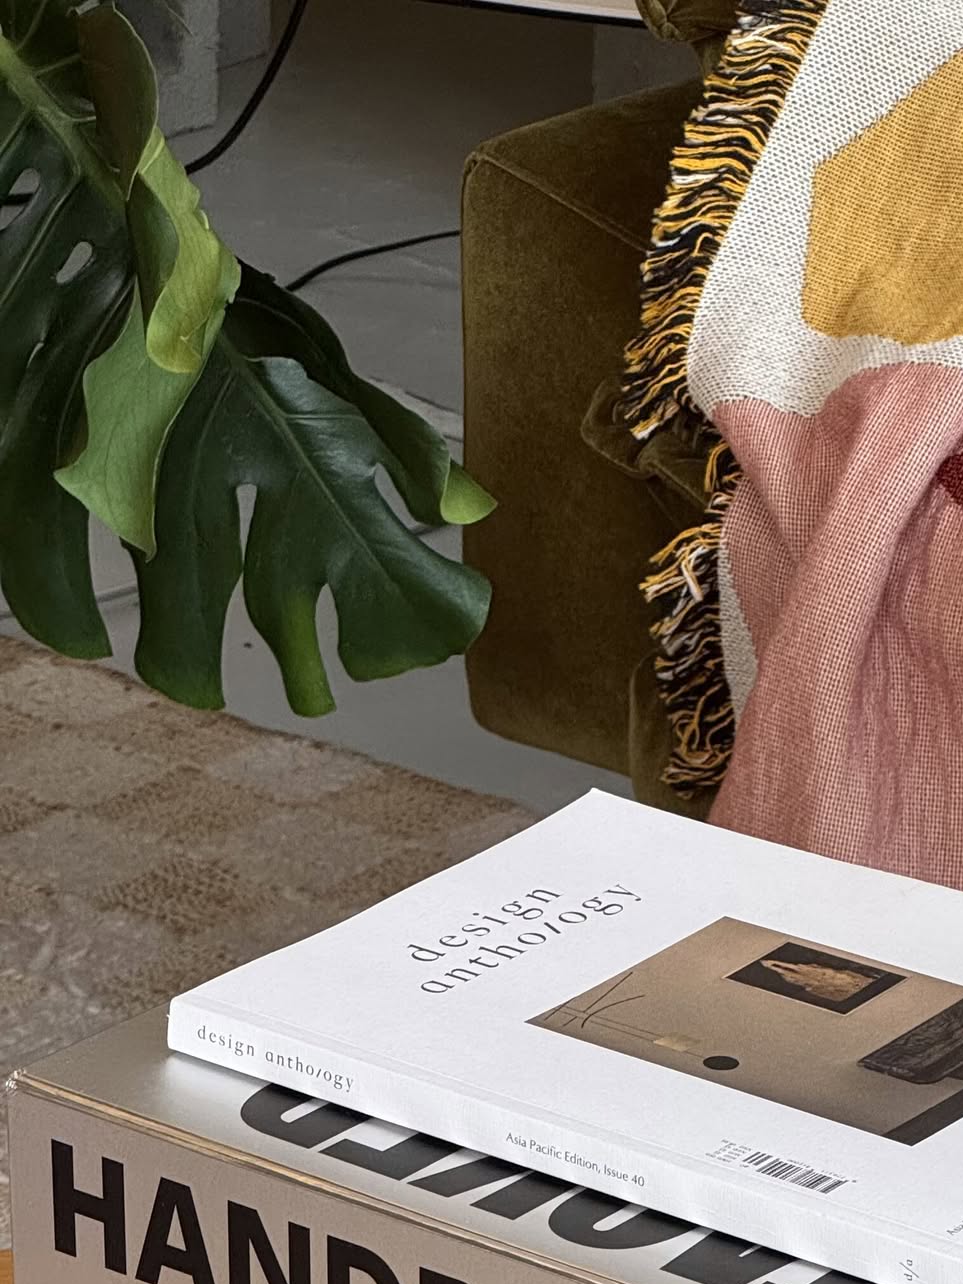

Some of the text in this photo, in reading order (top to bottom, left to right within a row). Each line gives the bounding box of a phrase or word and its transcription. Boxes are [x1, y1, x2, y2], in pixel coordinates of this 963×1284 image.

[407, 888, 563, 962] design
[196, 1025, 255, 1057] design
[506, 1132, 645, 1187] Asia Pacific Edition, Issue 40
